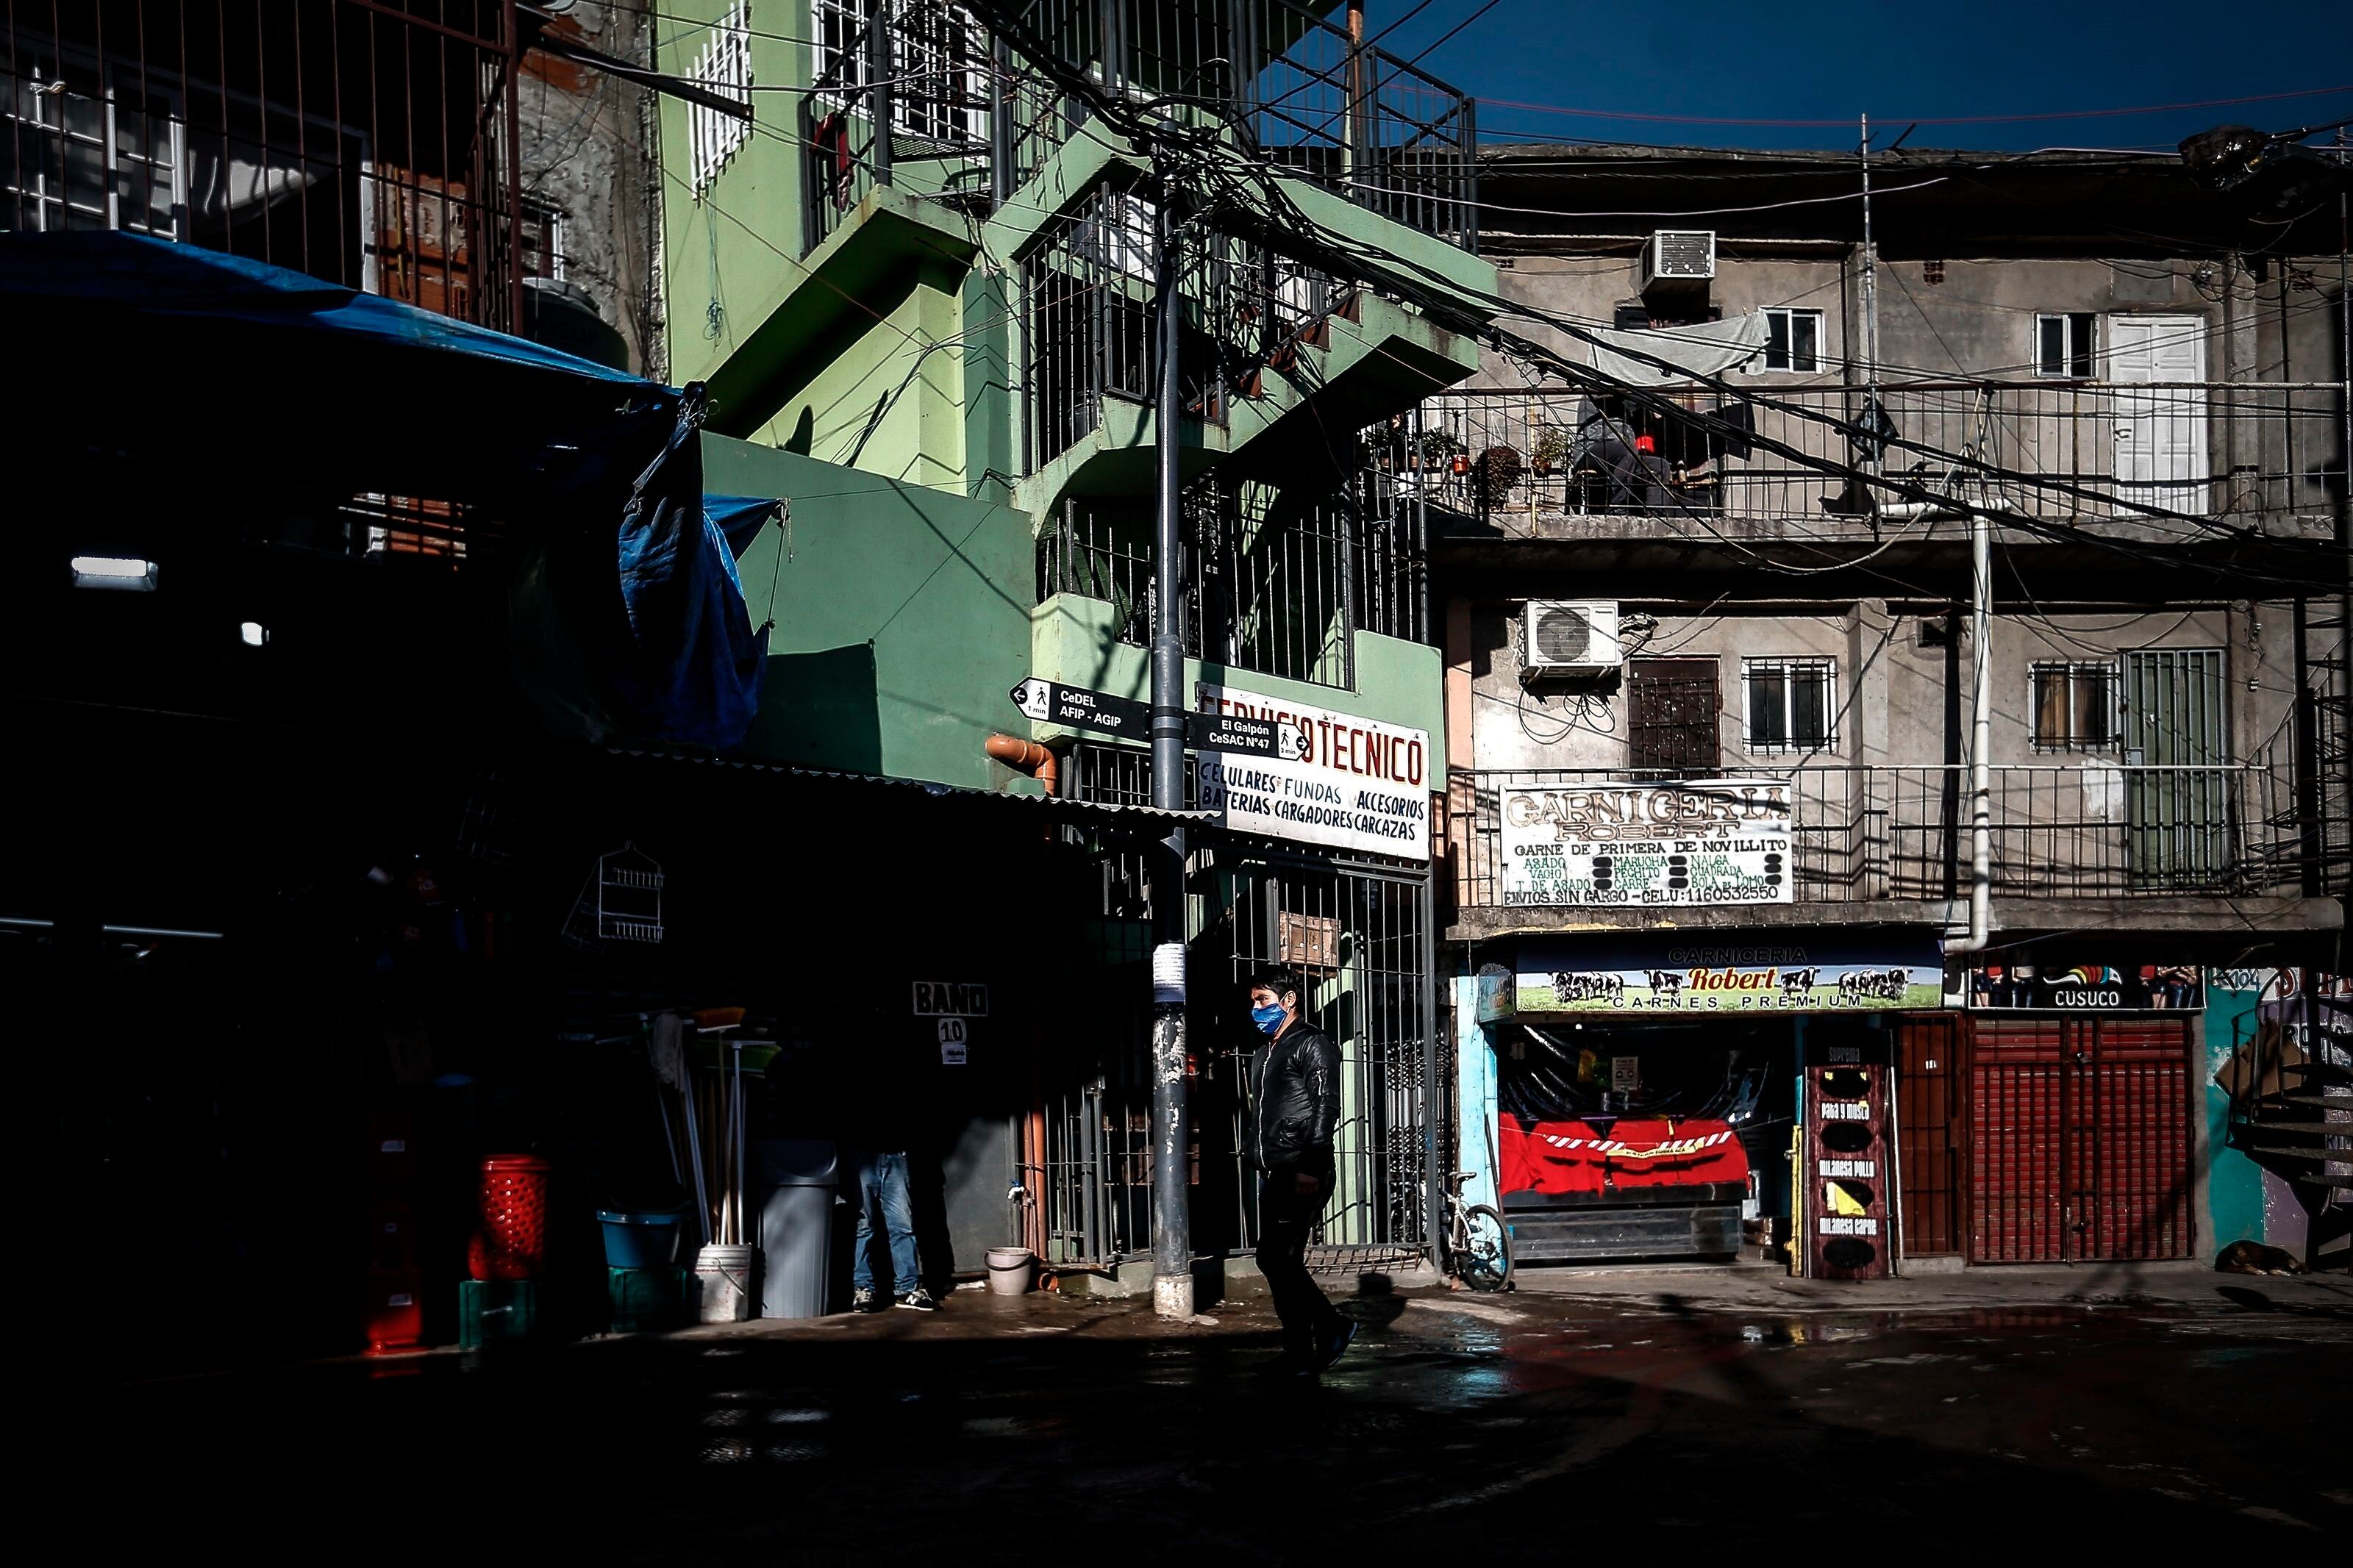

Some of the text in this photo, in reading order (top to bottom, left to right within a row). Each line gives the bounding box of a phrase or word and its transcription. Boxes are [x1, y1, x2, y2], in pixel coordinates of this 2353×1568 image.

[1060, 690, 1097, 708] CeDEL
[1060, 706, 1085, 720] AFIP
[1094, 715, 1121, 727] AGIP
[1221, 720, 1270, 736] El Galpón
[1209, 732, 1270, 749] CeSAC N°47
[1317, 720, 1423, 787] TECNICO
[1200, 762, 1425, 820] CELULARES FUNDAS ACCESORIOS
[1202, 785, 1415, 841] BATERIAS CARGADORES CARCAZAS
[1554, 821, 1740, 842] ROBERT
[1571, 844, 1590, 856] DE
[1599, 842, 1666, 855] PRIMERA
[1674, 841, 1697, 853] DE
[1702, 840, 1787, 852] NOVILLITO
[1523, 857, 1565, 869] ASADO
[1613, 855, 1668, 867] MARUCHA
[1690, 854, 1729, 866] NALGA
[1529, 870, 1562, 879] VACIO
[1614, 867, 1660, 878] PECHITO
[1690, 865, 1743, 877] CUADRADA
[1532, 880, 1547, 891] DE
[1552, 879, 1590, 891] ASADO
[1614, 878, 1651, 889] CARRE
[1691, 877, 1717, 889] BOLA
[1736, 875, 1764, 887] LOMO
[1504, 890, 1551, 906] ENVIOS
[1555, 890, 1580, 903] SIN
[1584, 889, 1628, 903] CARGO
[1668, 946, 1807, 964] CARNICERIA
[1688, 965, 1776, 990] Robert
[1613, 995, 1860, 1009] CARNES PREMIUM
[2055, 991, 2119, 1006] CUSUCO
[940, 1020, 963, 1042] 10
